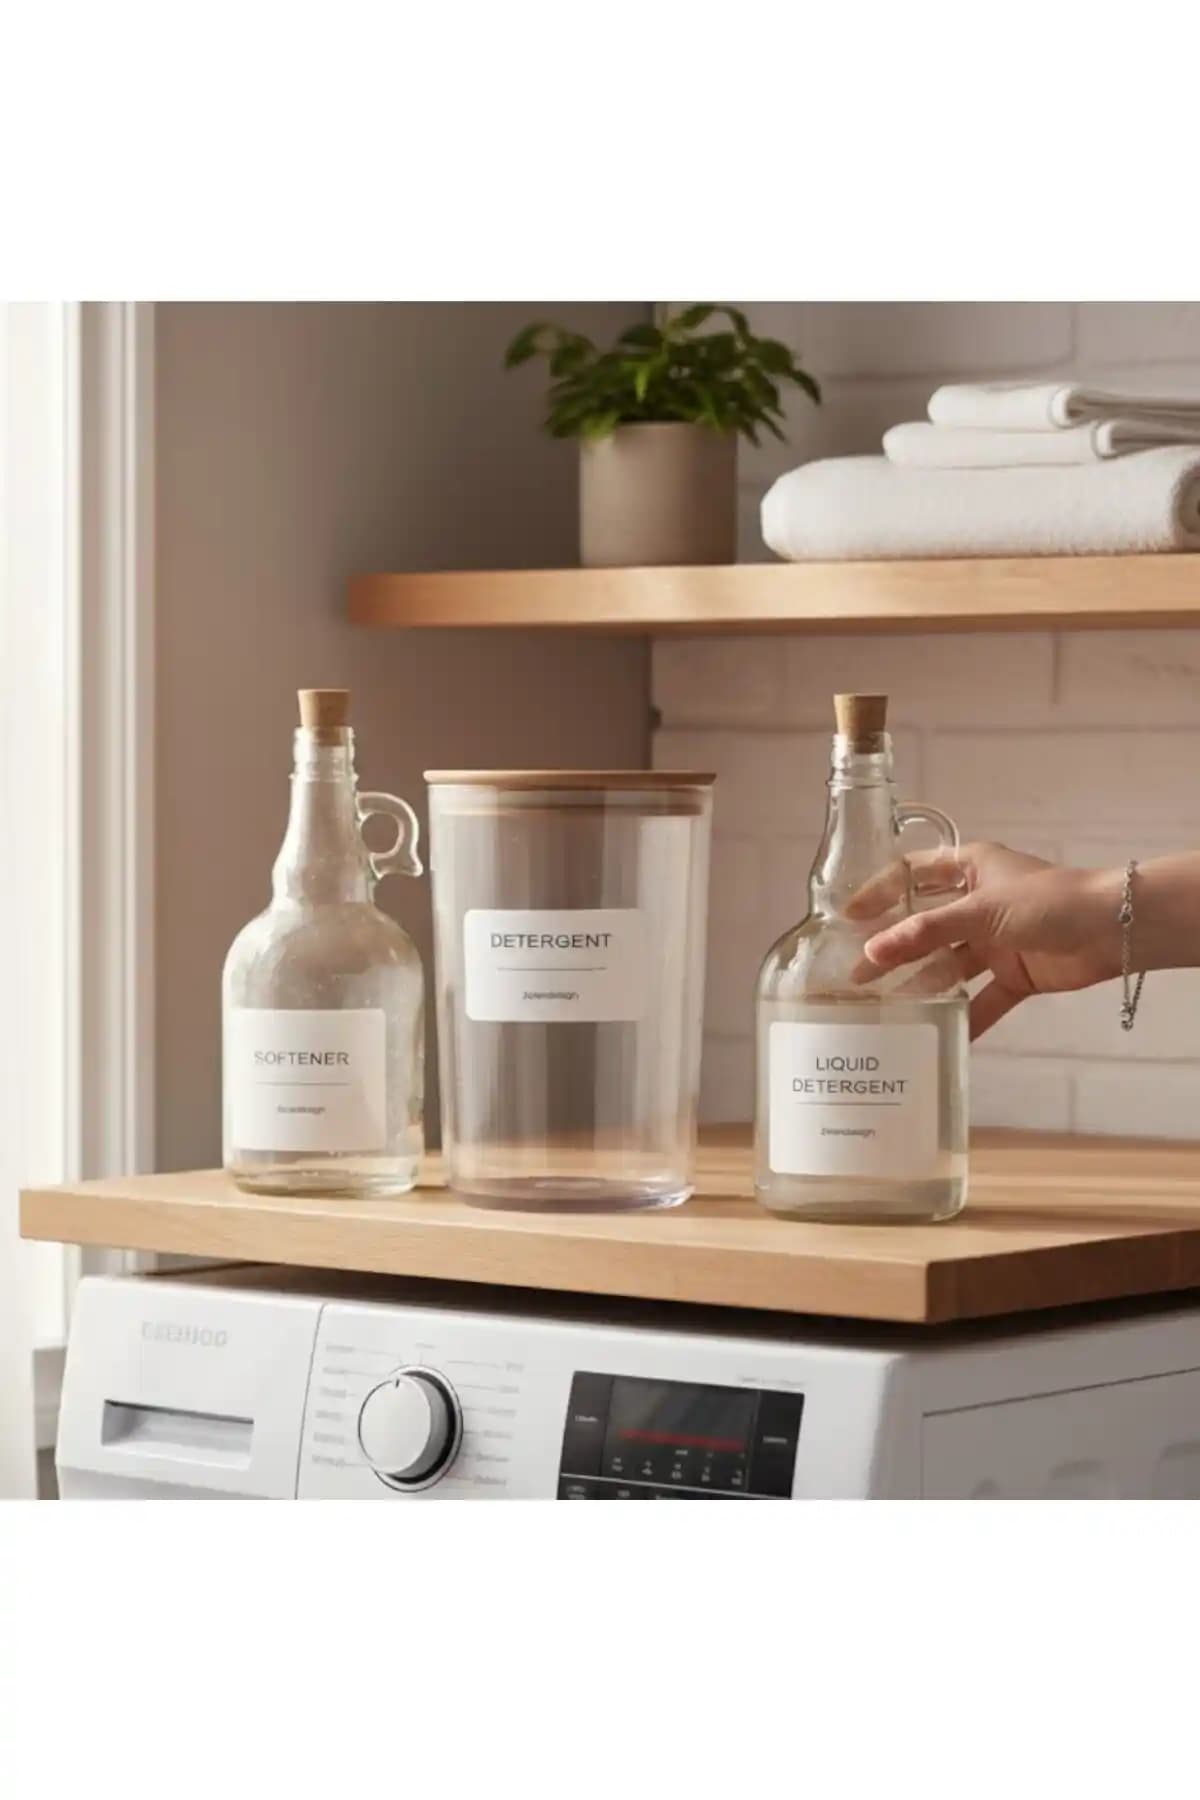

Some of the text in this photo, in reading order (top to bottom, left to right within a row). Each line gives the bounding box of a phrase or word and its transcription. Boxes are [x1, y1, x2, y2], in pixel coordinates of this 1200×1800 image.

[490, 932, 612, 949] DETERGENT
[254, 1051, 350, 1066] SOFTENER
[815, 1056, 880, 1072] LIQUID
[791, 1078, 906, 1095] DETERGENT
